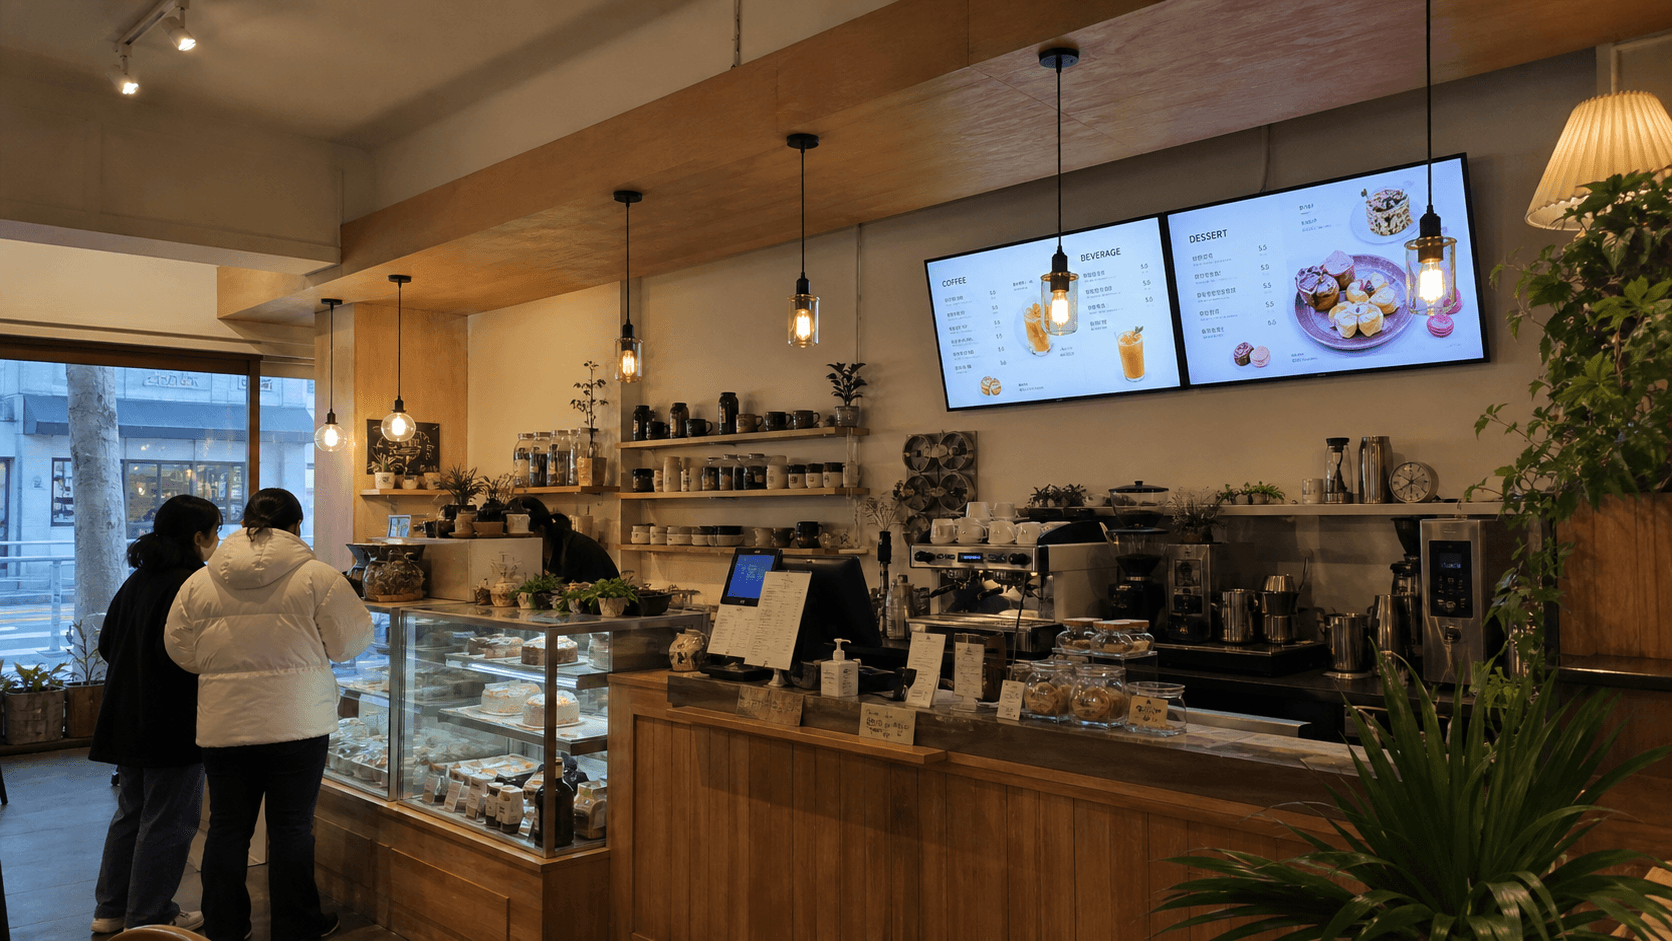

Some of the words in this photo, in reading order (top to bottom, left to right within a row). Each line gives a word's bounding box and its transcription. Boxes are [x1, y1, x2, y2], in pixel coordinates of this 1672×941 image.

[1189, 229, 1227, 243] DESSERT
[1080, 247, 1121, 262] BEVERAGE
[942, 276, 967, 287] COFFEE
